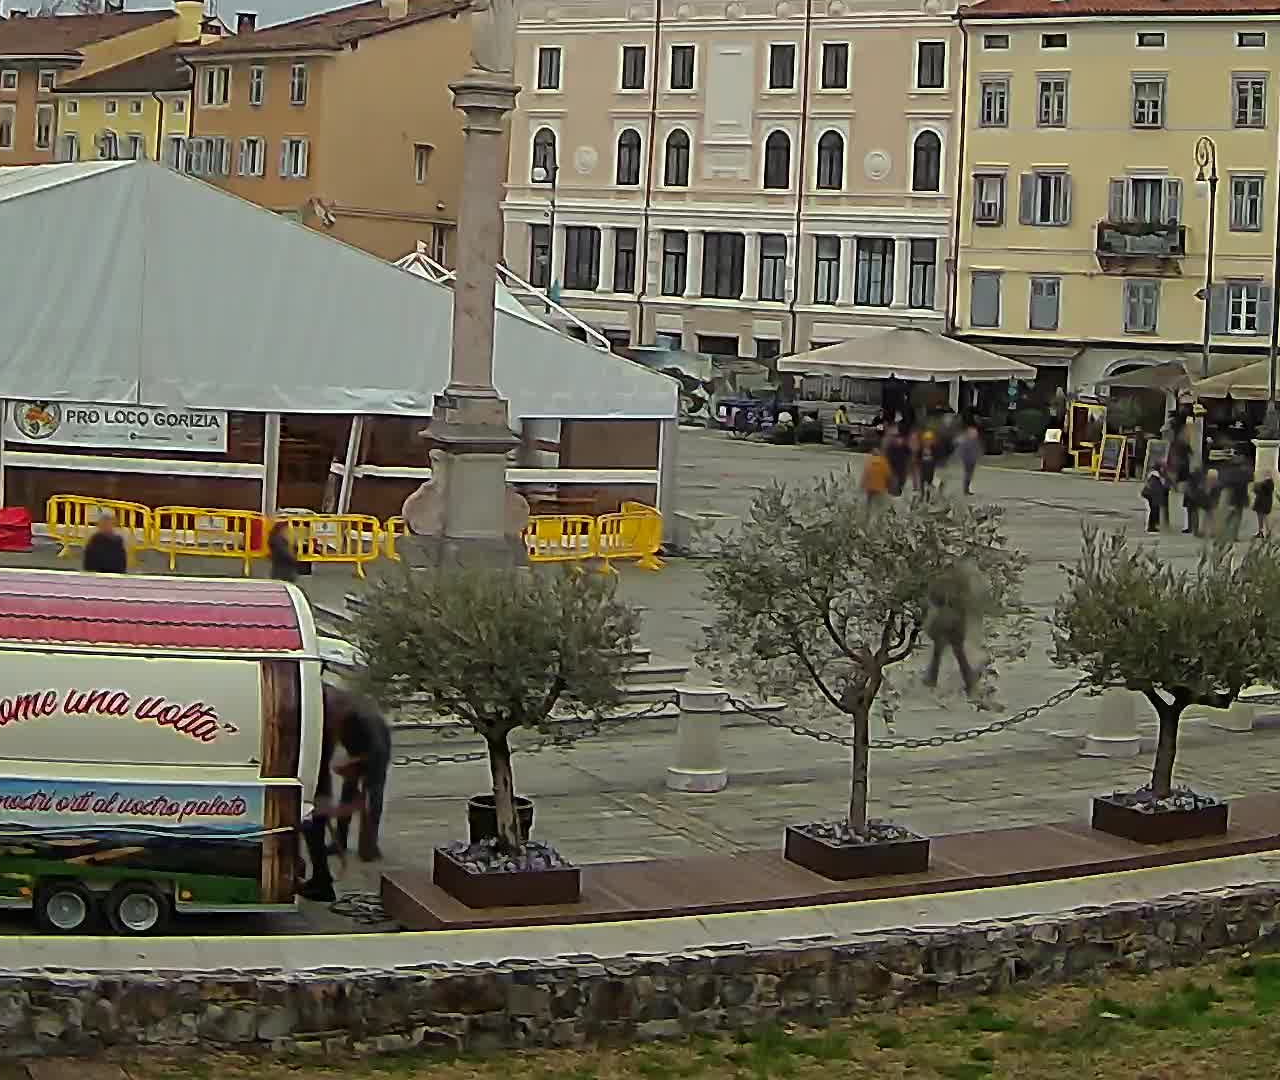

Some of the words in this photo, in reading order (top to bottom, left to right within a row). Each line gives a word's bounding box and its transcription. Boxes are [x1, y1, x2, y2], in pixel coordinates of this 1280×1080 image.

[66, 409, 100, 424] PRO
[104, 410, 149, 427] LOCO
[153, 413, 220, 428] GORIZIA
[63, 688, 130, 716] una
[55, 791, 94, 813] orti
[93, 792, 116, 813] al
[117, 794, 178, 817] vostro
[176, 794, 247, 823] palato
